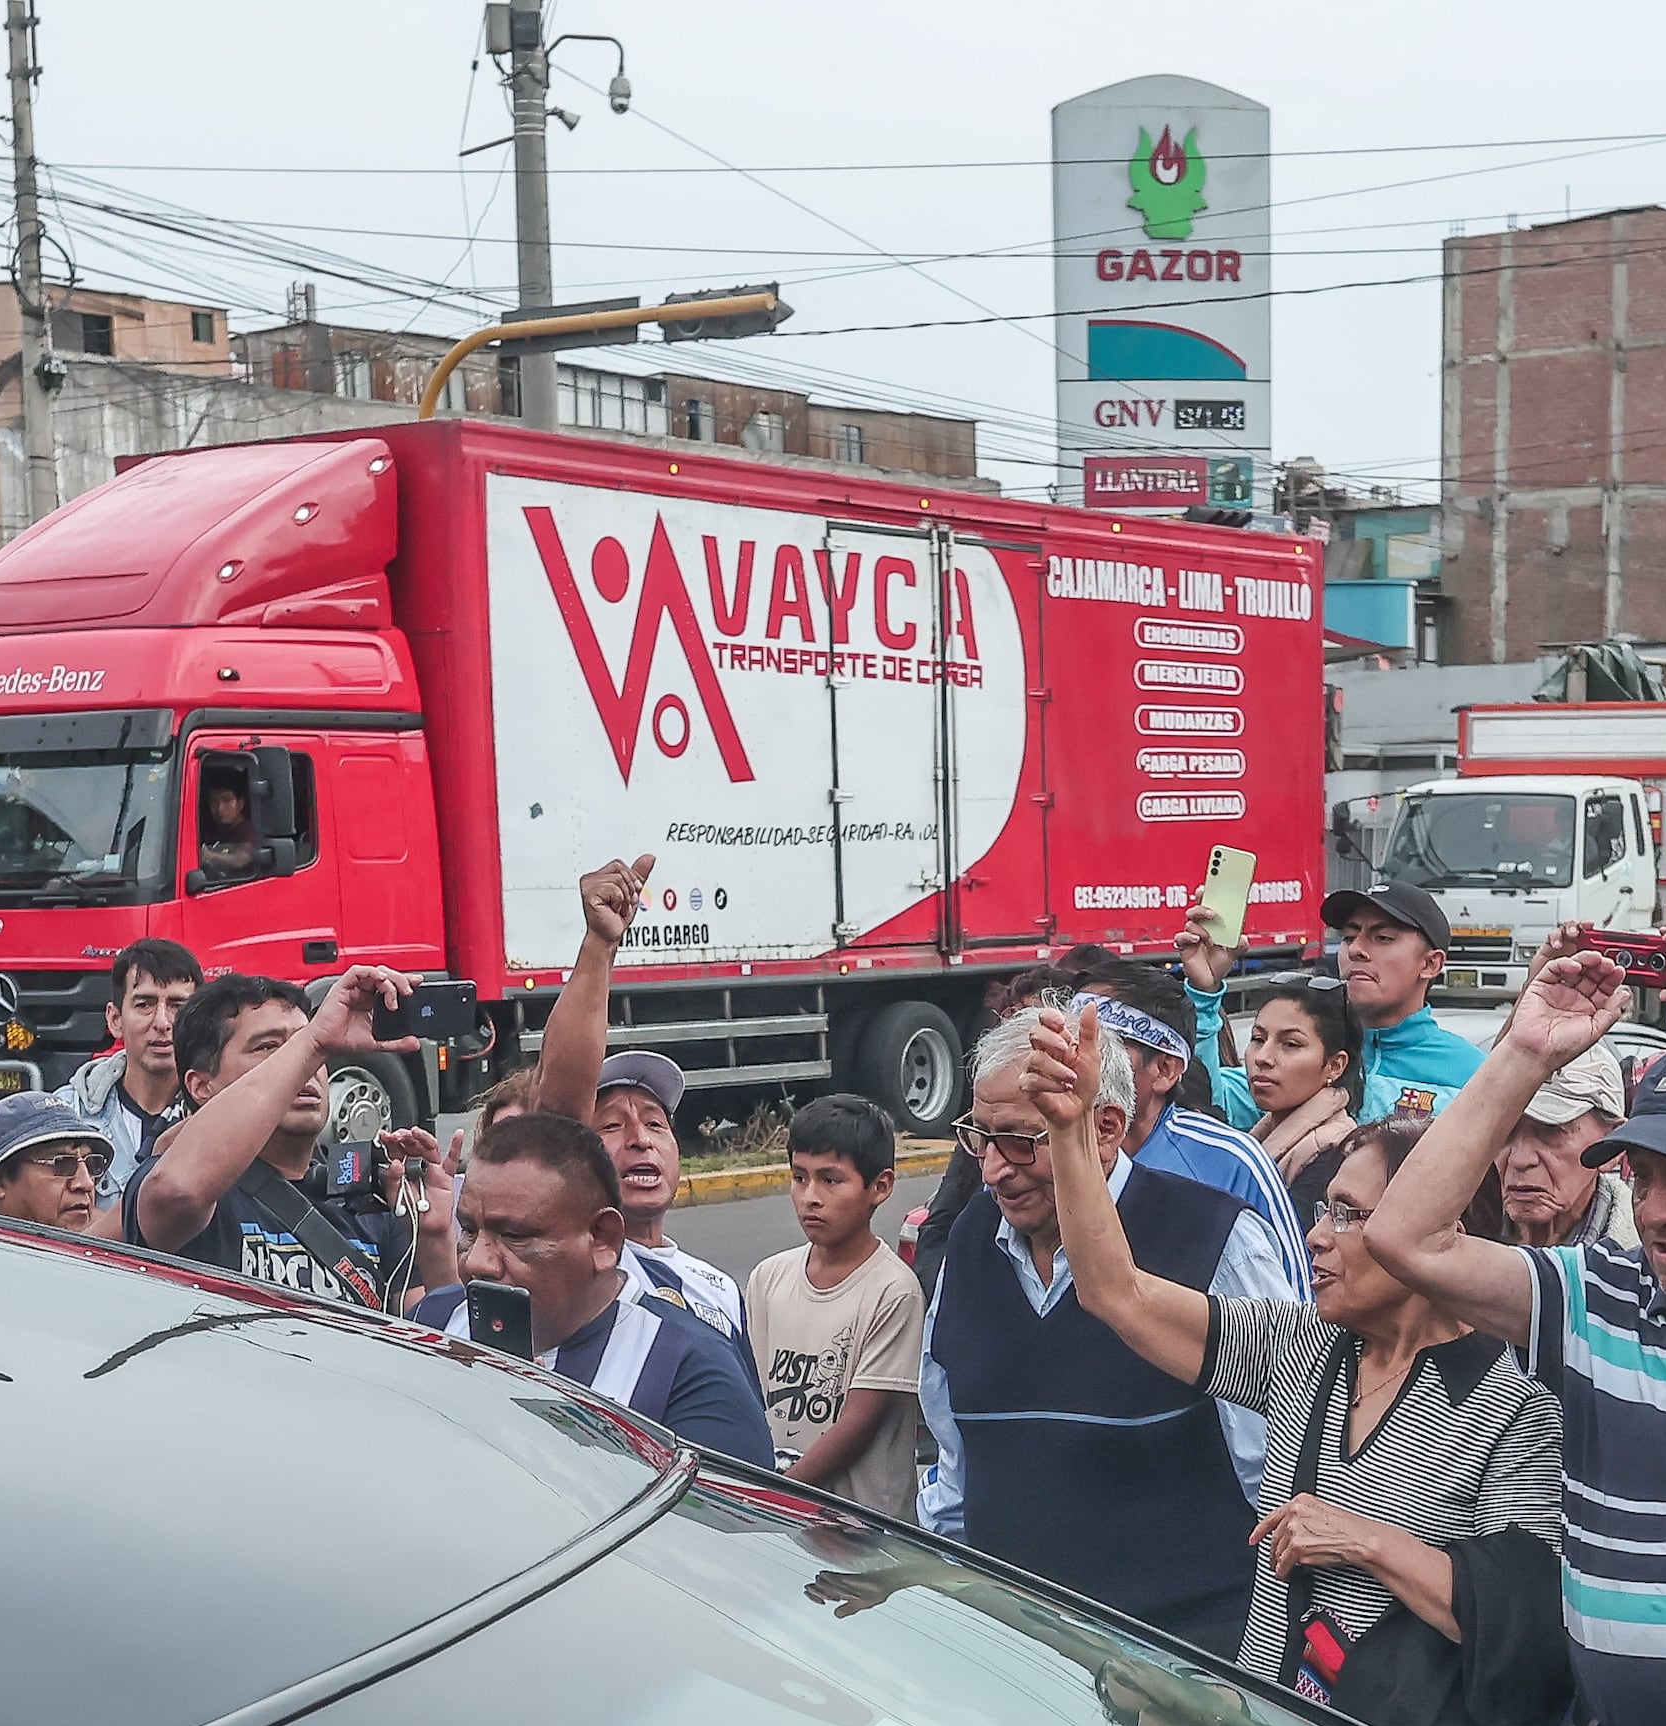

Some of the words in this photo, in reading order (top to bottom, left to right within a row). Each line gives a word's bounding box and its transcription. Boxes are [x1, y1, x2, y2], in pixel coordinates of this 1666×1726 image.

[1096, 249, 1242, 282] GAZOR
[1094, 400, 1166, 427] GNV
[1094, 469, 1200, 492] LLANTERIA
[701, 535, 979, 660] VAYCA
[1046, 554, 1167, 608] CAJAMARCA
[1178, 569, 1224, 612] LIMA
[1234, 575, 1313, 621] TRUJILLO
[1143, 624, 1236, 649] ENCOMIENDAS
[713, 642, 877, 679] TRANSPORTE
[883, 656, 912, 682] DE
[1143, 665, 1237, 688] MENSAJERIA
[1148, 711, 1235, 731] MUDANZAS
[1140, 754, 1188, 773] CARGA
[1188, 755, 1241, 773] PESADA
[1142, 798, 1188, 816] CARGA
[1189, 797, 1242, 815] LIVIANA
[664, 923, 710, 946] CARGO
[768, 1349, 818, 1384] JUST
